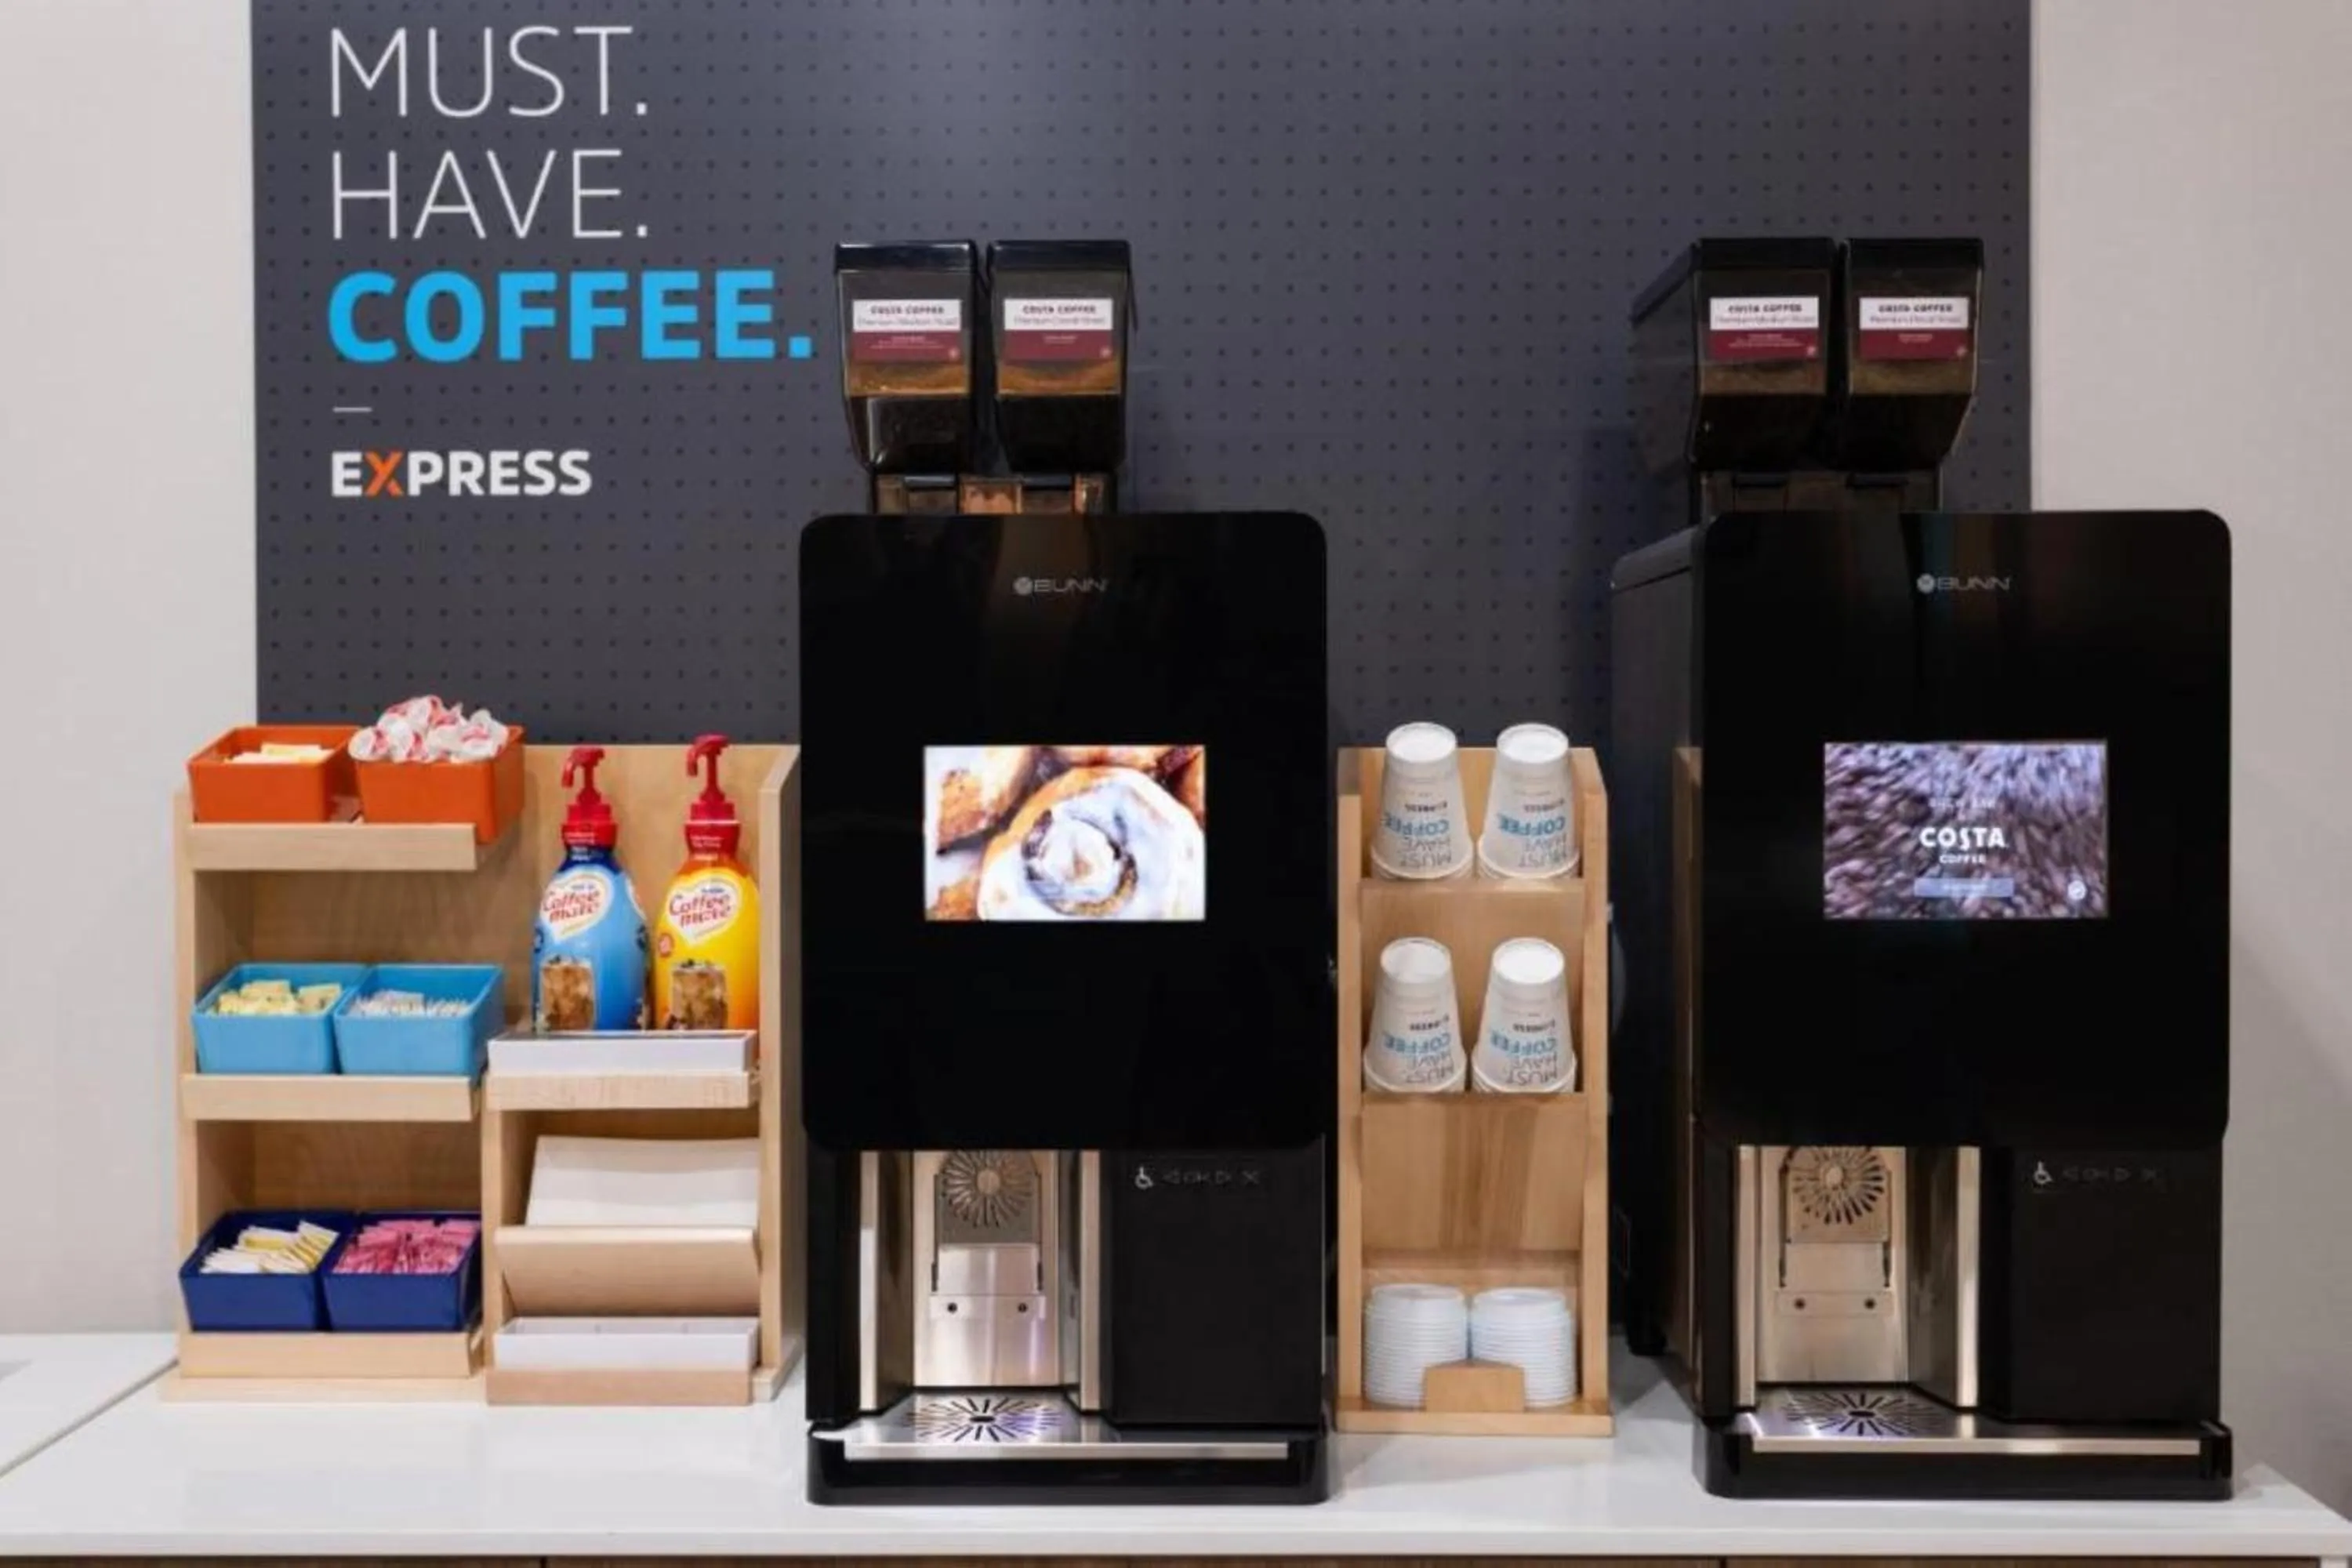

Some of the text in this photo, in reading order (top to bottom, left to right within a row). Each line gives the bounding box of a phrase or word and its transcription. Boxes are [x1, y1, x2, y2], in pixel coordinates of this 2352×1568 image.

[331, 26, 648, 117] MUST.
[332, 149, 648, 239] HAVE.
[328, 269, 812, 363] COFFEE.
[331, 448, 593, 497] EXPRESS
[1034, 579, 1108, 593] BUNN
[1936, 575, 2010, 590] BUNN
[1919, 827, 2006, 851] COSTA
[1940, 854, 1987, 863] COFFEE
